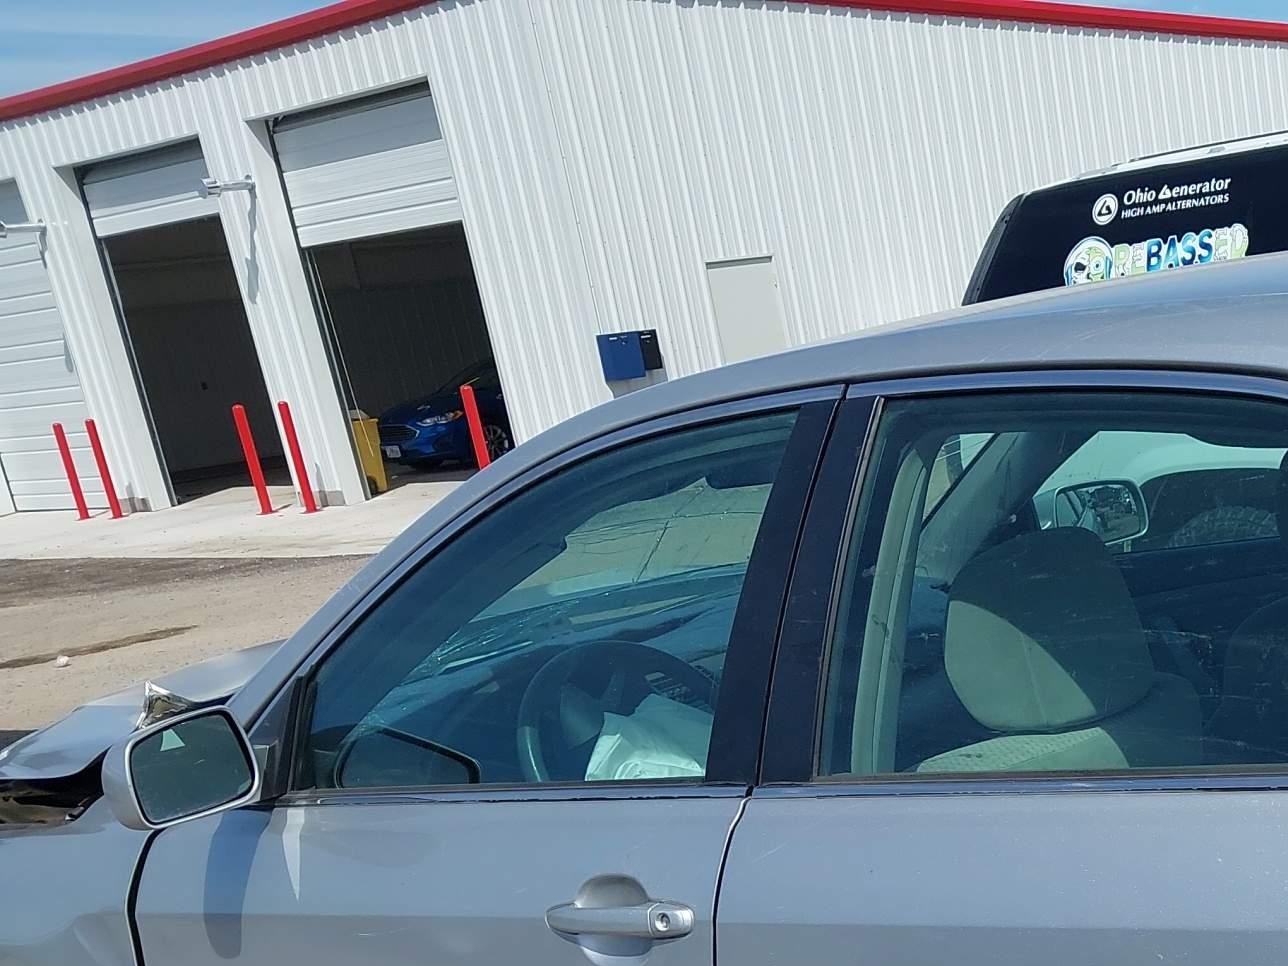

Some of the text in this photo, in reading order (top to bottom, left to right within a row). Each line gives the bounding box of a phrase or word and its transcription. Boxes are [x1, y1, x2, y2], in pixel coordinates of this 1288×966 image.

[1121, 193, 1230, 219] HIGH AMP ALTERNATORS
[1124, 187, 1156, 205] Ohio
